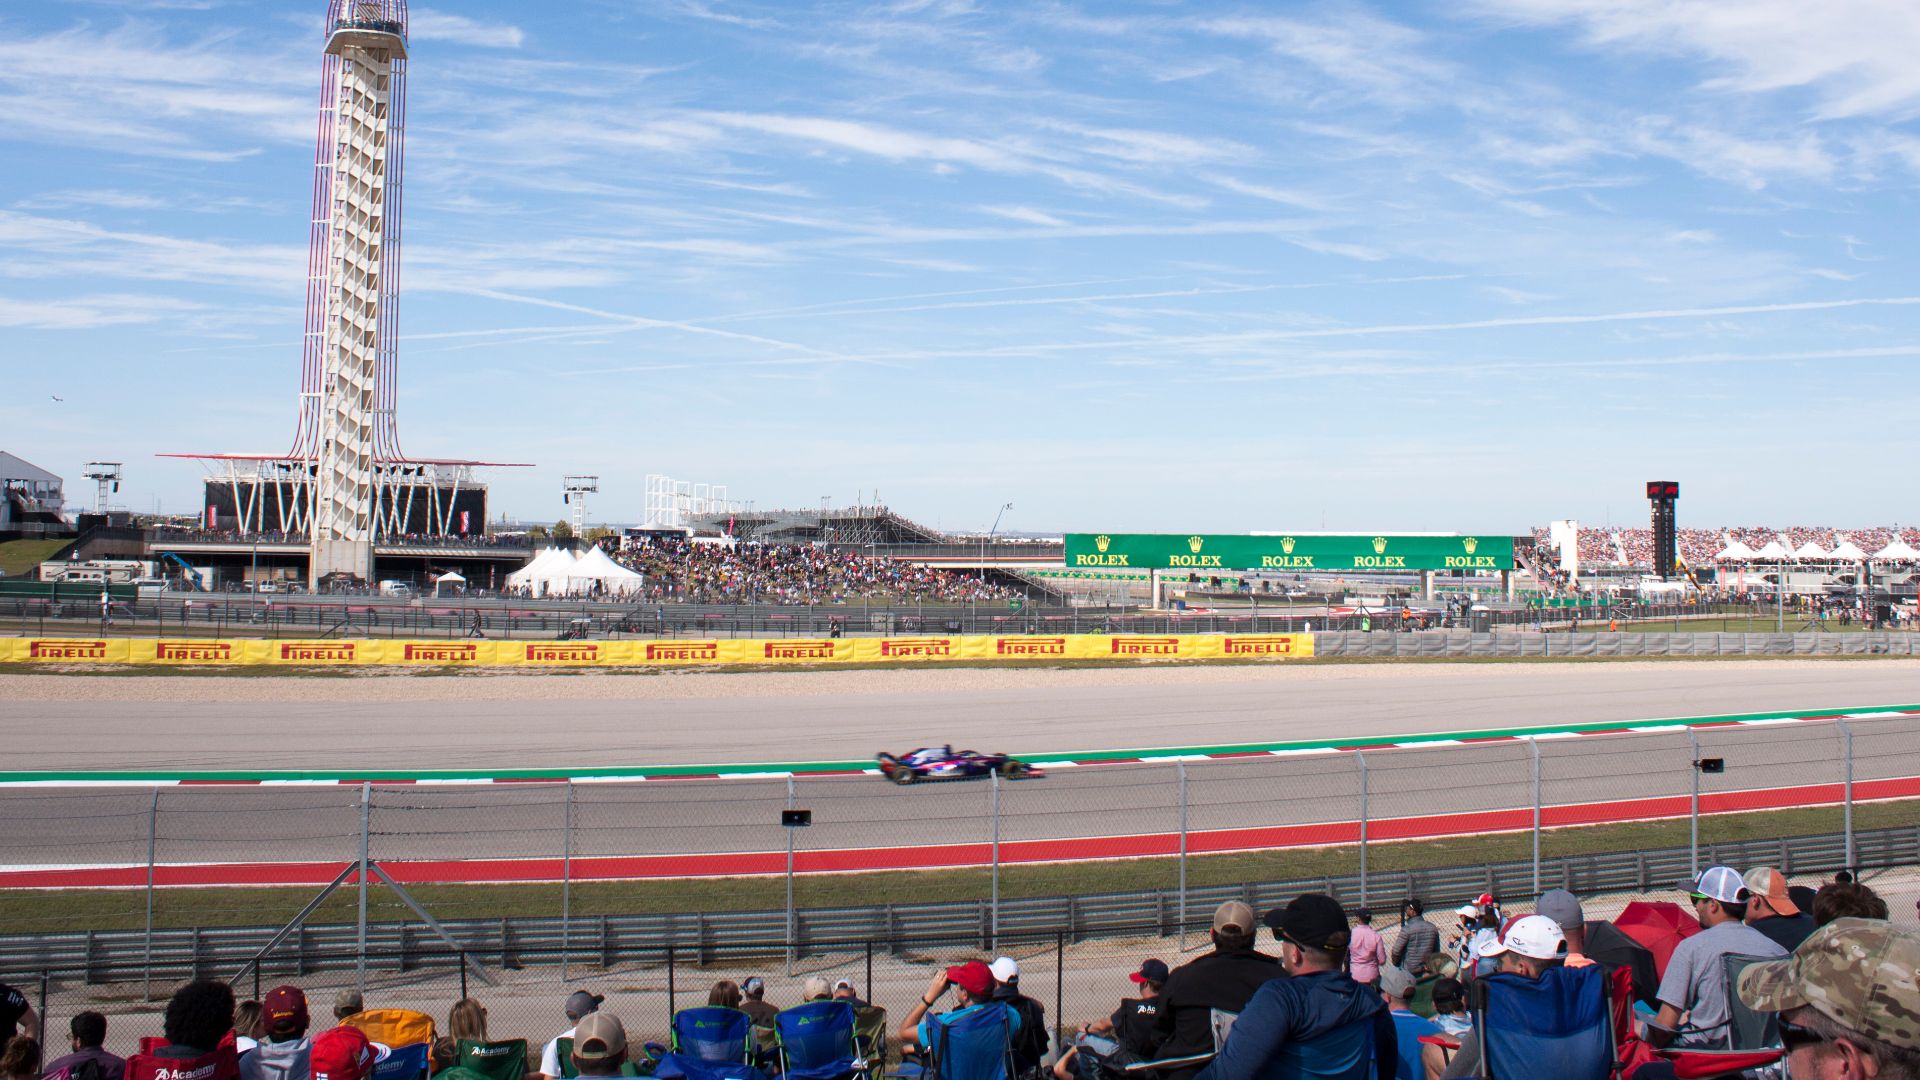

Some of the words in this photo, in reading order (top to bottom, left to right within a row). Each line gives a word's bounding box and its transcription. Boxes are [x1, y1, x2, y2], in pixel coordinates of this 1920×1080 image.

[1076, 554, 1130, 566] ROLEX
[1169, 555, 1222, 567] ROLEX
[1261, 556, 1314, 568] ROLEX
[1354, 556, 1406, 568] ROLEX
[1445, 556, 1497, 568] ROLEX
[31, 641, 106, 658] PIRELLI
[157, 642, 231, 660] PIRELLI
[281, 644, 354, 661] PIRELLI
[404, 644, 477, 660] PIRELLI
[527, 645, 598, 661] PIRELLI
[646, 644, 717, 660] PIRELLI
[765, 642, 834, 658] PIRELLI
[882, 640, 950, 656] PIRELLI
[997, 639, 1065, 654] PIRELLI
[1112, 639, 1178, 654] PIRELLI
[1225, 638, 1290, 653] PIRELLI
[480, 1047, 510, 1056] Academy
[171, 1064, 216, 1079] Academy
